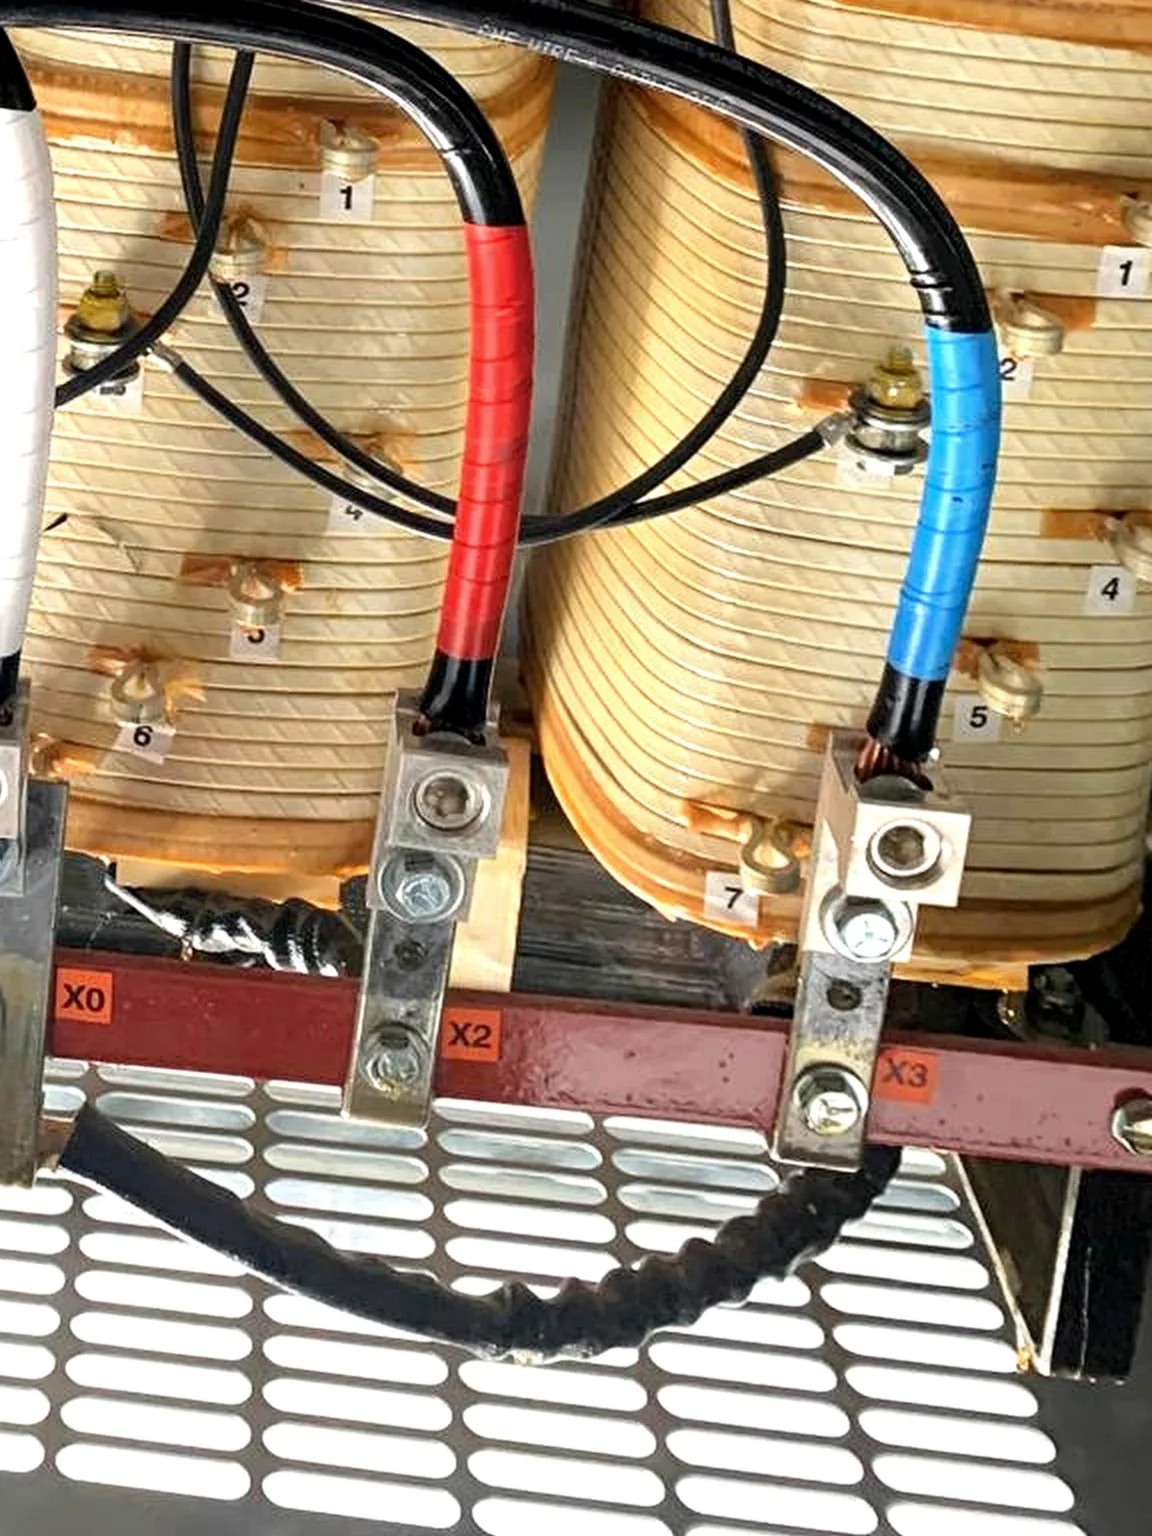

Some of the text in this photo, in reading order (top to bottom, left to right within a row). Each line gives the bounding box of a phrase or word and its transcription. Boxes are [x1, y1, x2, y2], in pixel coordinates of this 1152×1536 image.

[339, 185, 352, 210] 1
[1119, 259, 1134, 286] 1
[1000, 357, 1017, 381] 2
[1100, 576, 1120, 601] 4
[969, 705, 988, 729] 5
[133, 725, 153, 747] 6
[724, 885, 744, 909] 7
[448, 1021, 492, 1048] X2
[881, 1057, 929, 1088] X3
